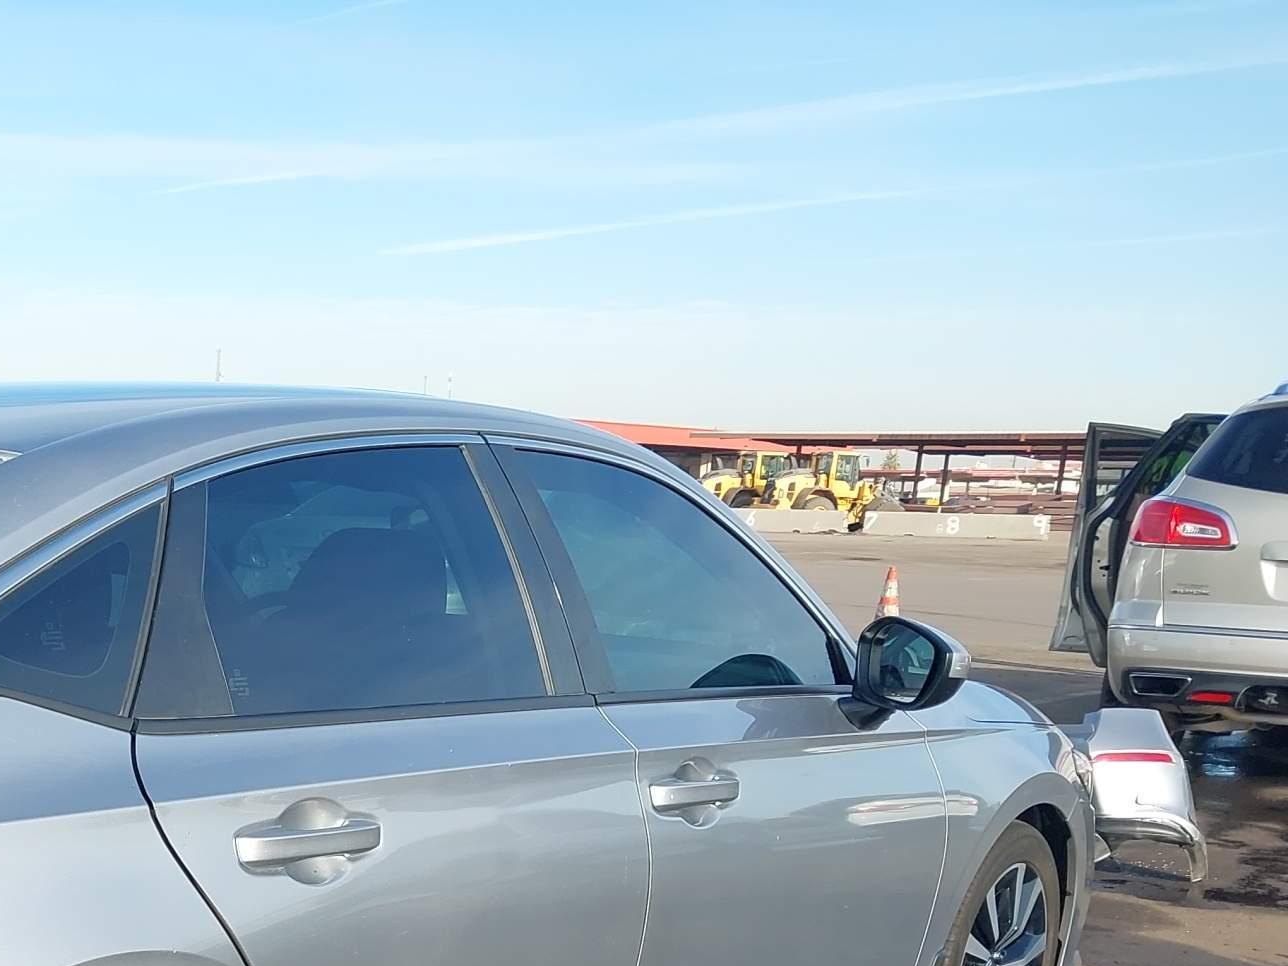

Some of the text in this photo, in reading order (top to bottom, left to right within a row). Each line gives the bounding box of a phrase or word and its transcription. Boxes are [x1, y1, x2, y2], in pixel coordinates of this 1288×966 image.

[865, 512, 878, 529] 7
[946, 516, 960, 535] 8
[1033, 515, 1047, 535] 9
